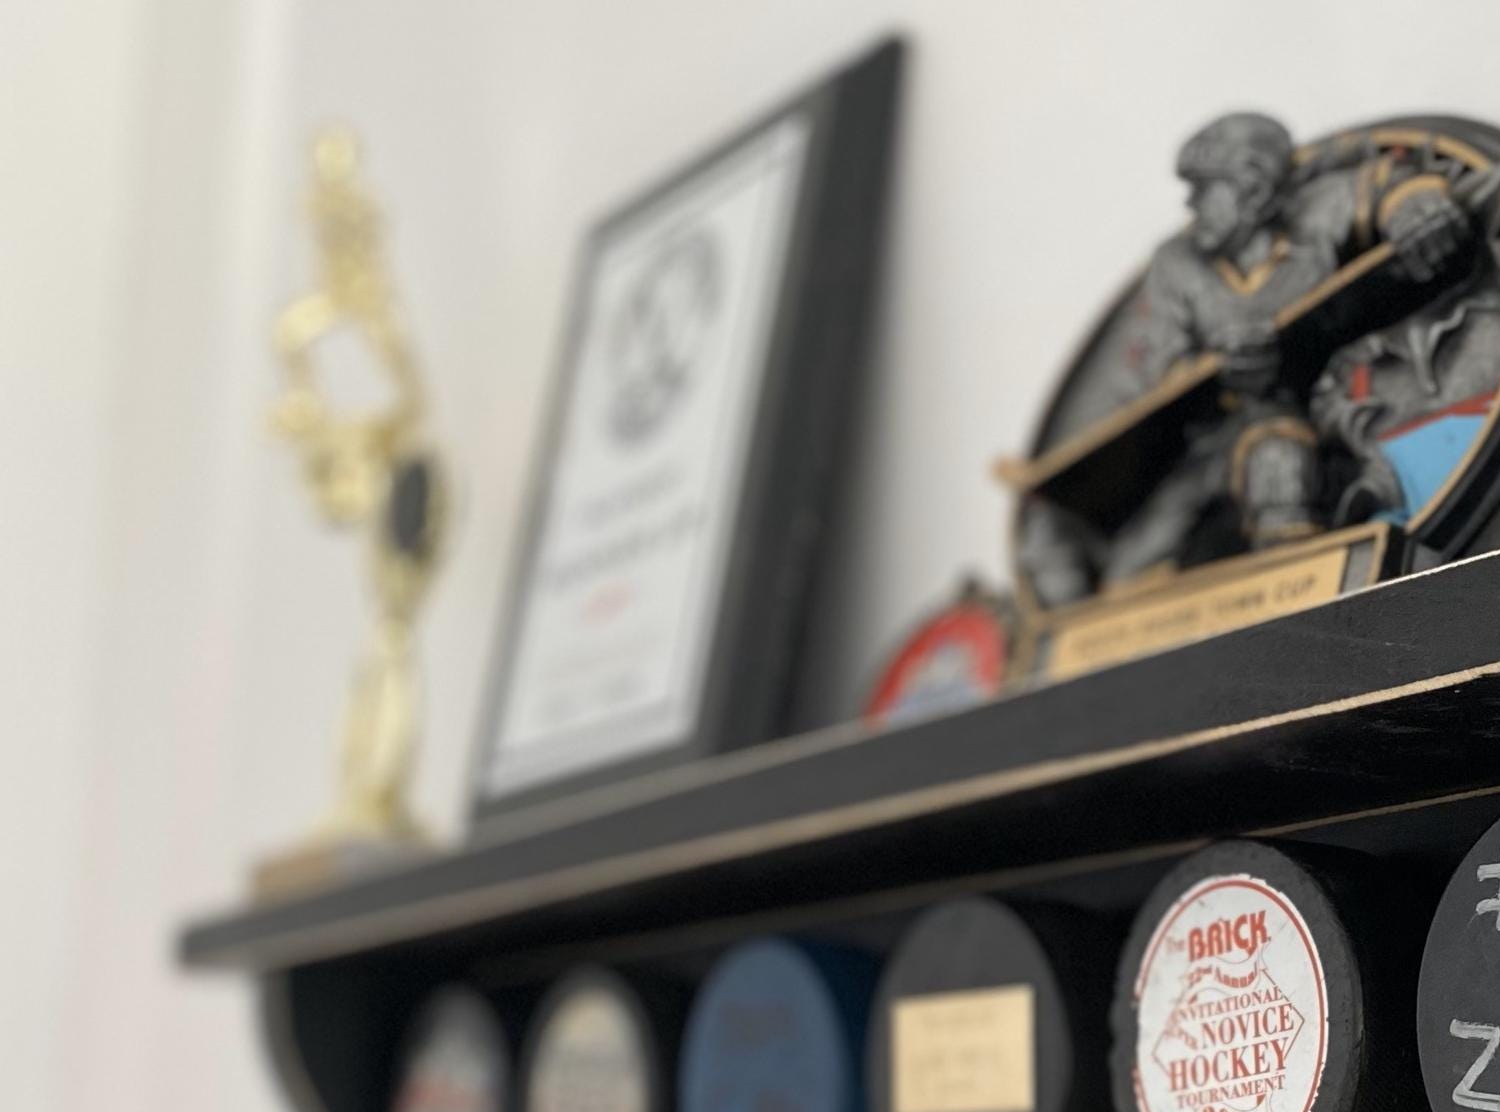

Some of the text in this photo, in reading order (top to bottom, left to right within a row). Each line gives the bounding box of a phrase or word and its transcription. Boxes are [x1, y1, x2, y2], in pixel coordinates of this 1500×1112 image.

[1188, 910, 1267, 962] BRICK
[1202, 1004, 1294, 1049] NOVICE
[1168, 1038, 1288, 1092] HOCKEY
[1176, 1075, 1286, 1109] TOURNAMENT
